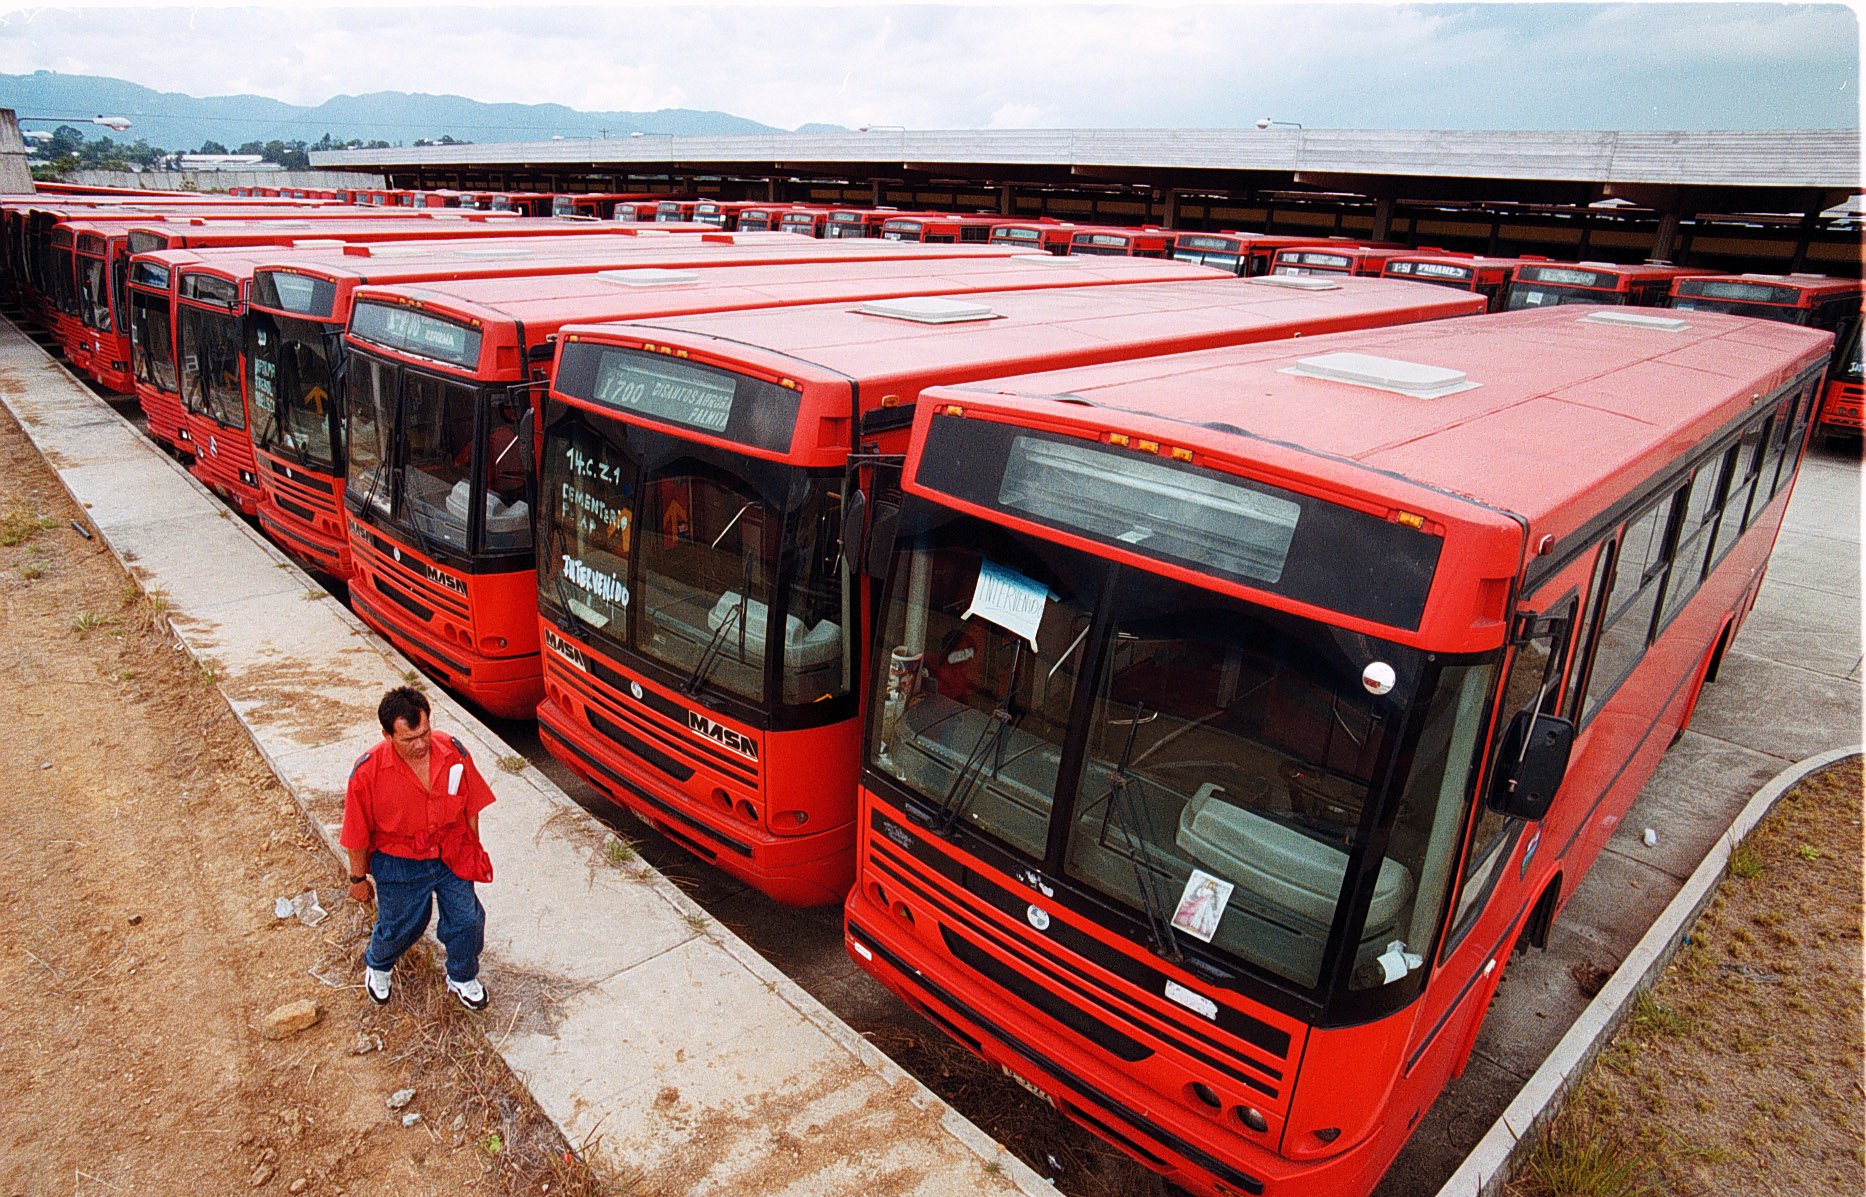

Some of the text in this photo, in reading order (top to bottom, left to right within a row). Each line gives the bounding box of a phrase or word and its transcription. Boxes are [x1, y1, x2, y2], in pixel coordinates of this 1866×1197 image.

[611, 380, 646, 404] 700
[427, 566, 468, 597] MASA
[545, 630, 584, 668] MASA
[689, 711, 757, 757] MASA
